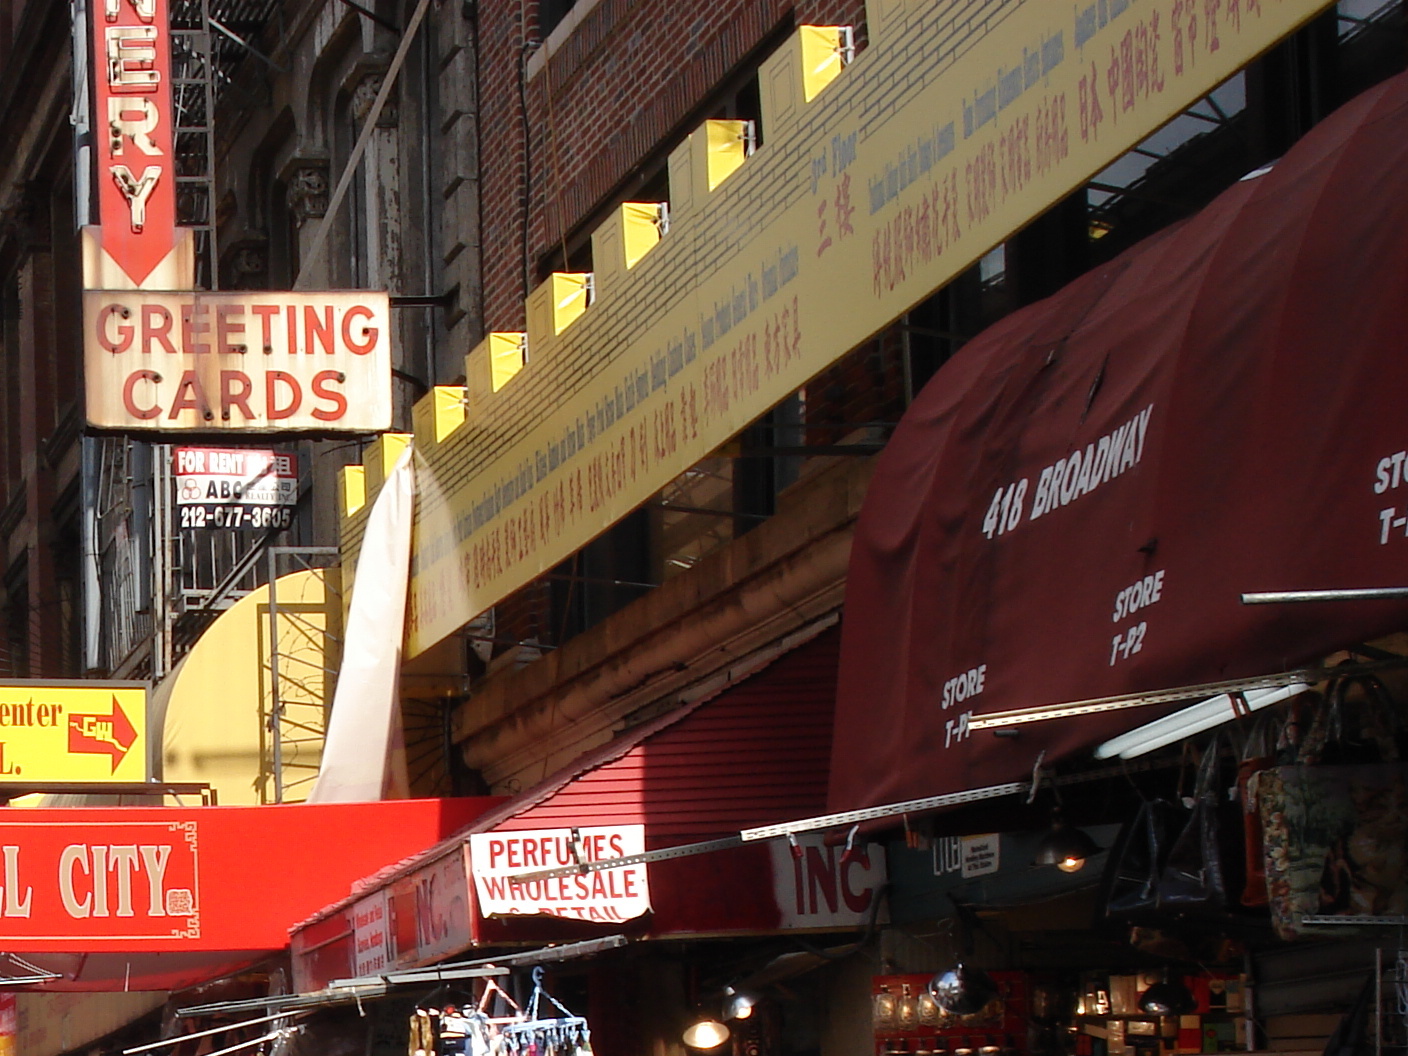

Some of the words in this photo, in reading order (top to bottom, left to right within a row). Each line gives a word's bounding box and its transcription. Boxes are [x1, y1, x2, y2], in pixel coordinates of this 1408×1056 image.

[95, 303, 379, 355] GREETING
[123, 368, 348, 422] CARDS
[178, 451, 205, 473] FOR
[209, 452, 244, 474] RENT
[983, 478, 1028, 540] 418
[1030, 404, 1153, 521] BROADWAY
[181, 505, 291, 528] 212-677-3605
[1379, 507, 1408, 545] T-
[1113, 570, 1165, 623] STORE
[1110, 622, 1147, 666] T-P2
[942, 664, 987, 710] STORE
[58, 844, 172, 918] CITY
[482, 869, 639, 902] WHOLESALE
[789, 844, 873, 915] INC
